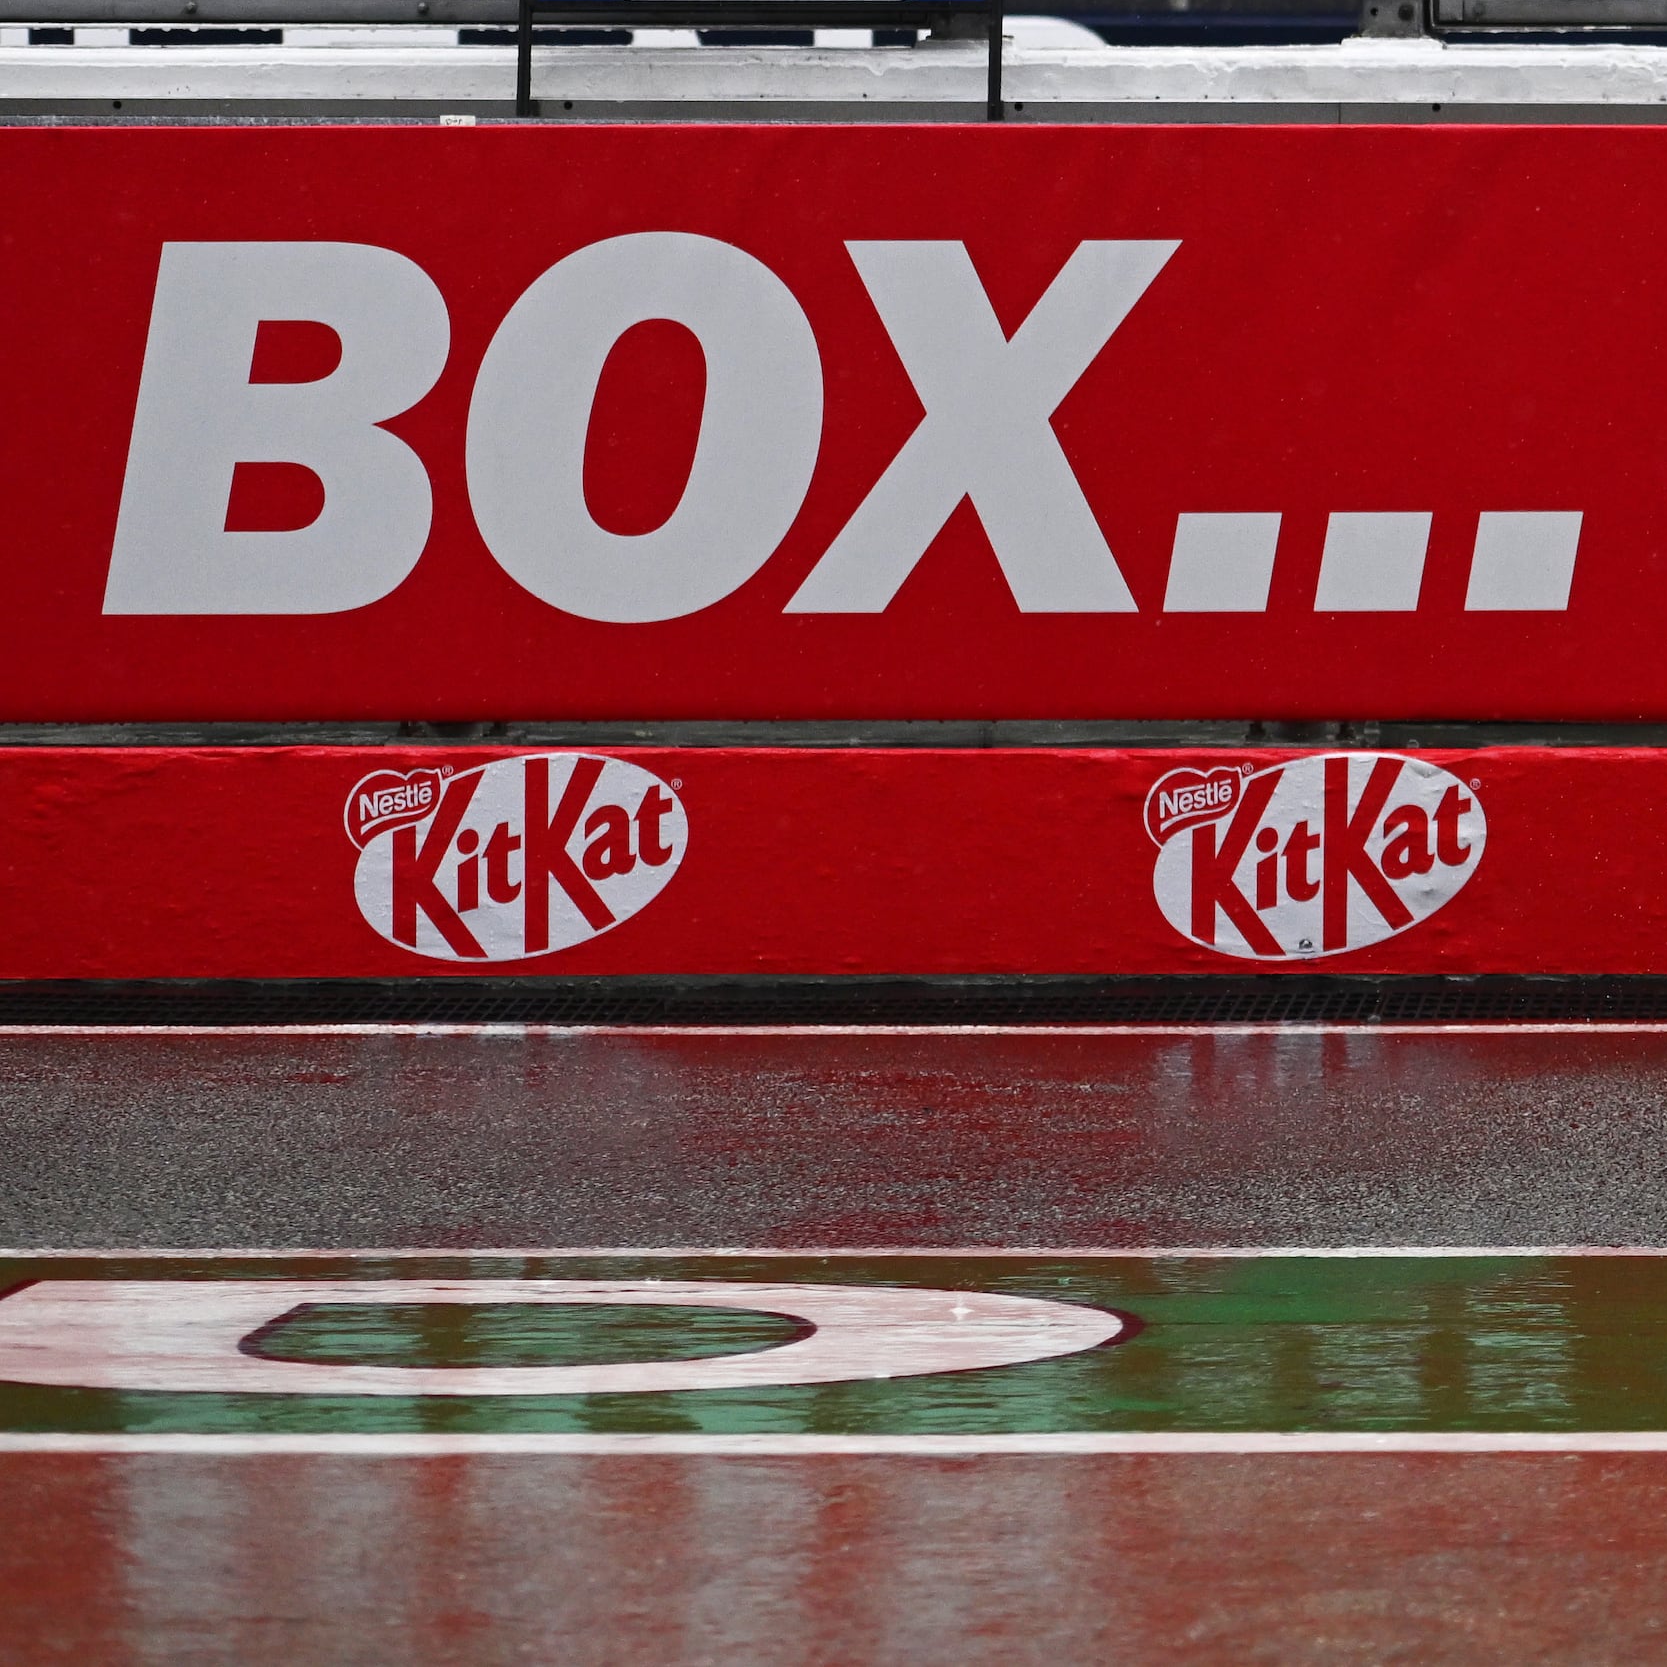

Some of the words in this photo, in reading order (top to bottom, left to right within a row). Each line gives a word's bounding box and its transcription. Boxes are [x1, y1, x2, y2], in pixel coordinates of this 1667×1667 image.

[102, 230, 1584, 624] BOX...
[392, 758, 674, 958] KitKat
[1191, 757, 1472, 956] KitKat
